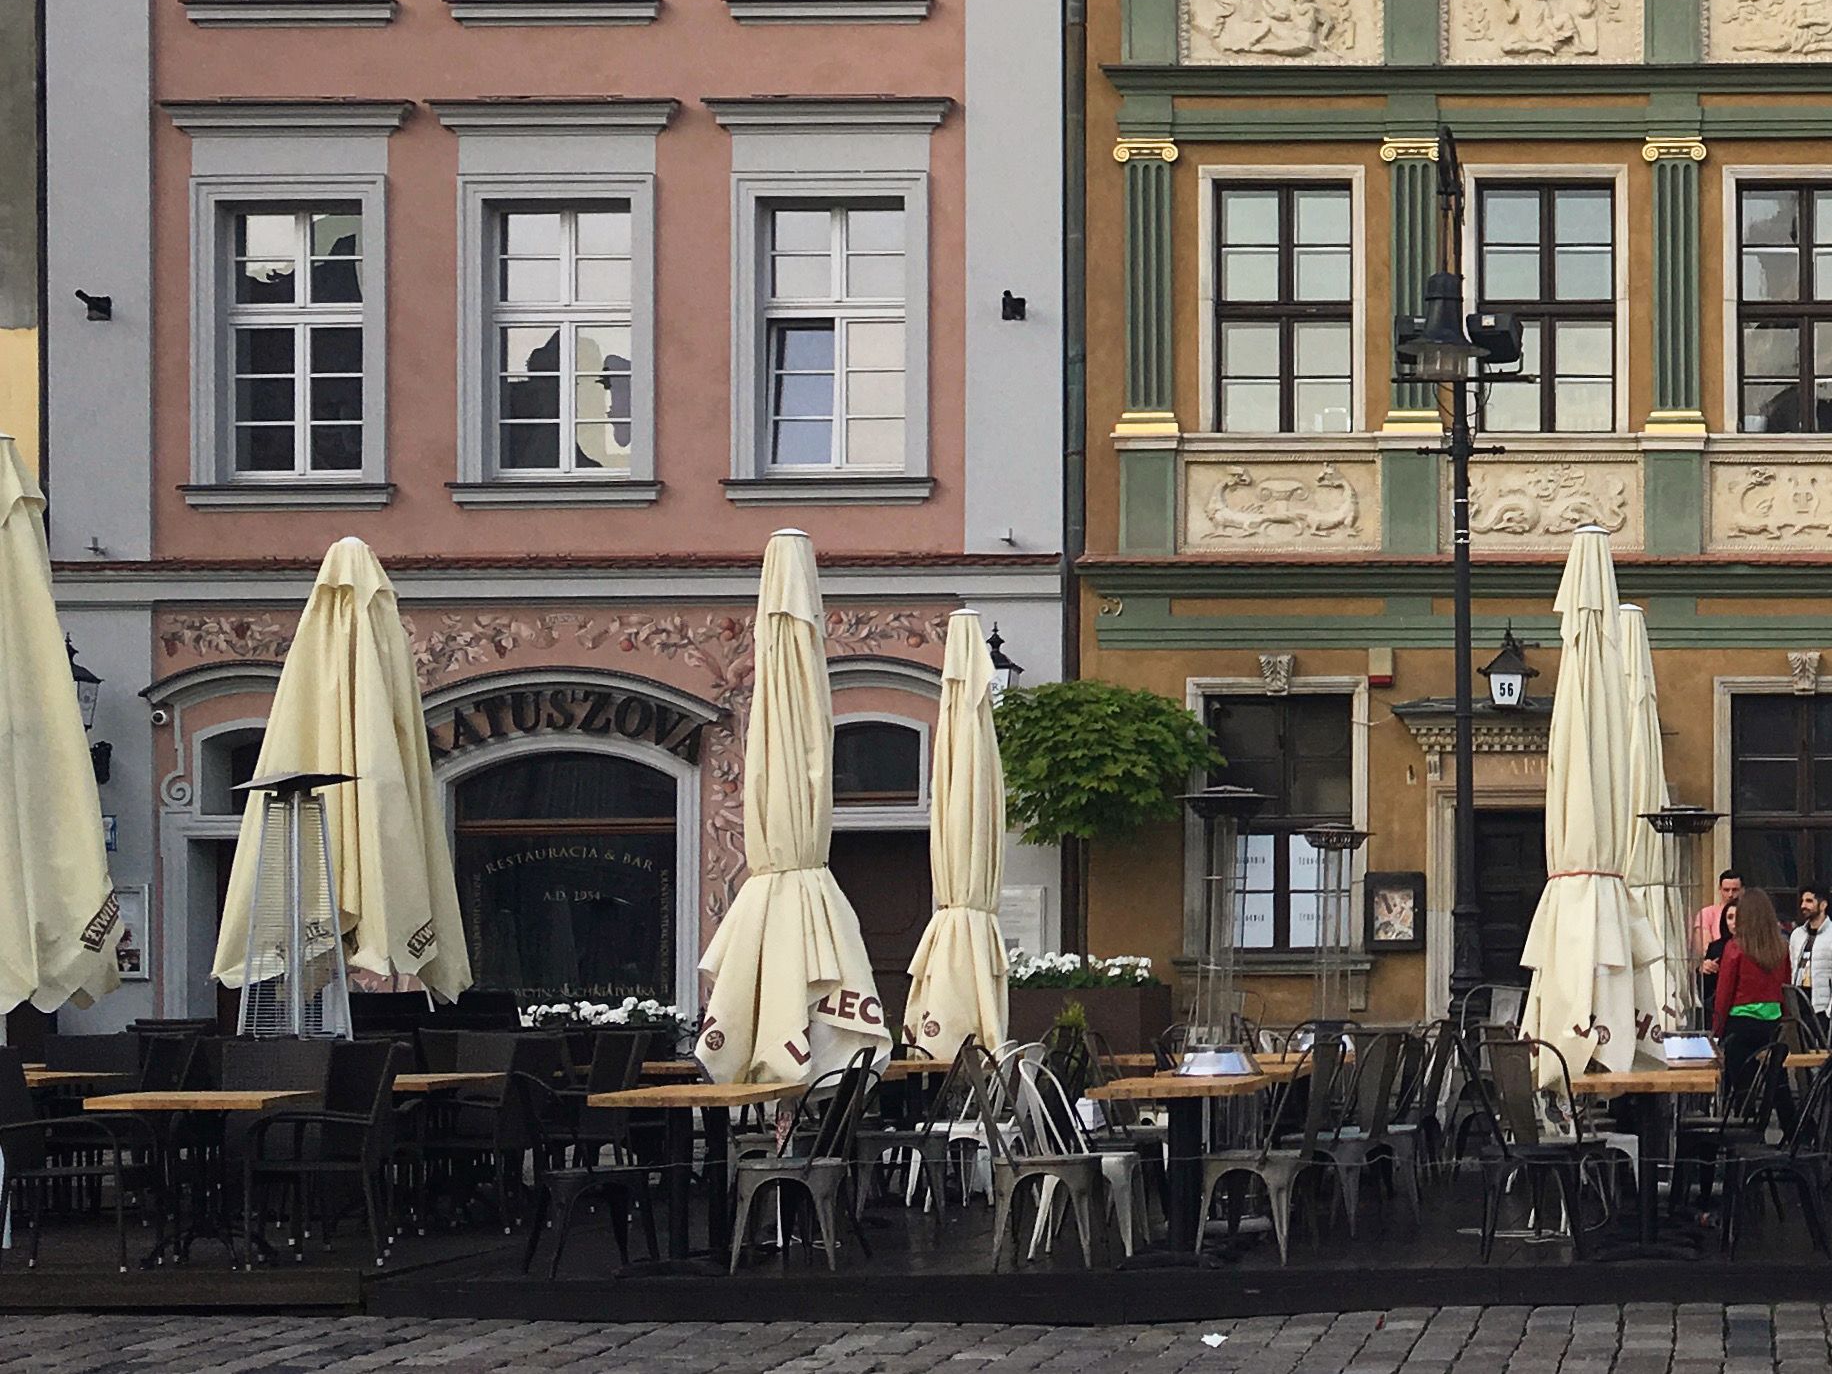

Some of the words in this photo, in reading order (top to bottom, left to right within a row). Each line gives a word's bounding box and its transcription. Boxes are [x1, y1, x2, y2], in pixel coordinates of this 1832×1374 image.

[1499, 682, 1514, 697] 56
[486, 846, 598, 875] RESTAURACJA
[604, 852, 615, 860] &
[623, 852, 653, 872] BAR
